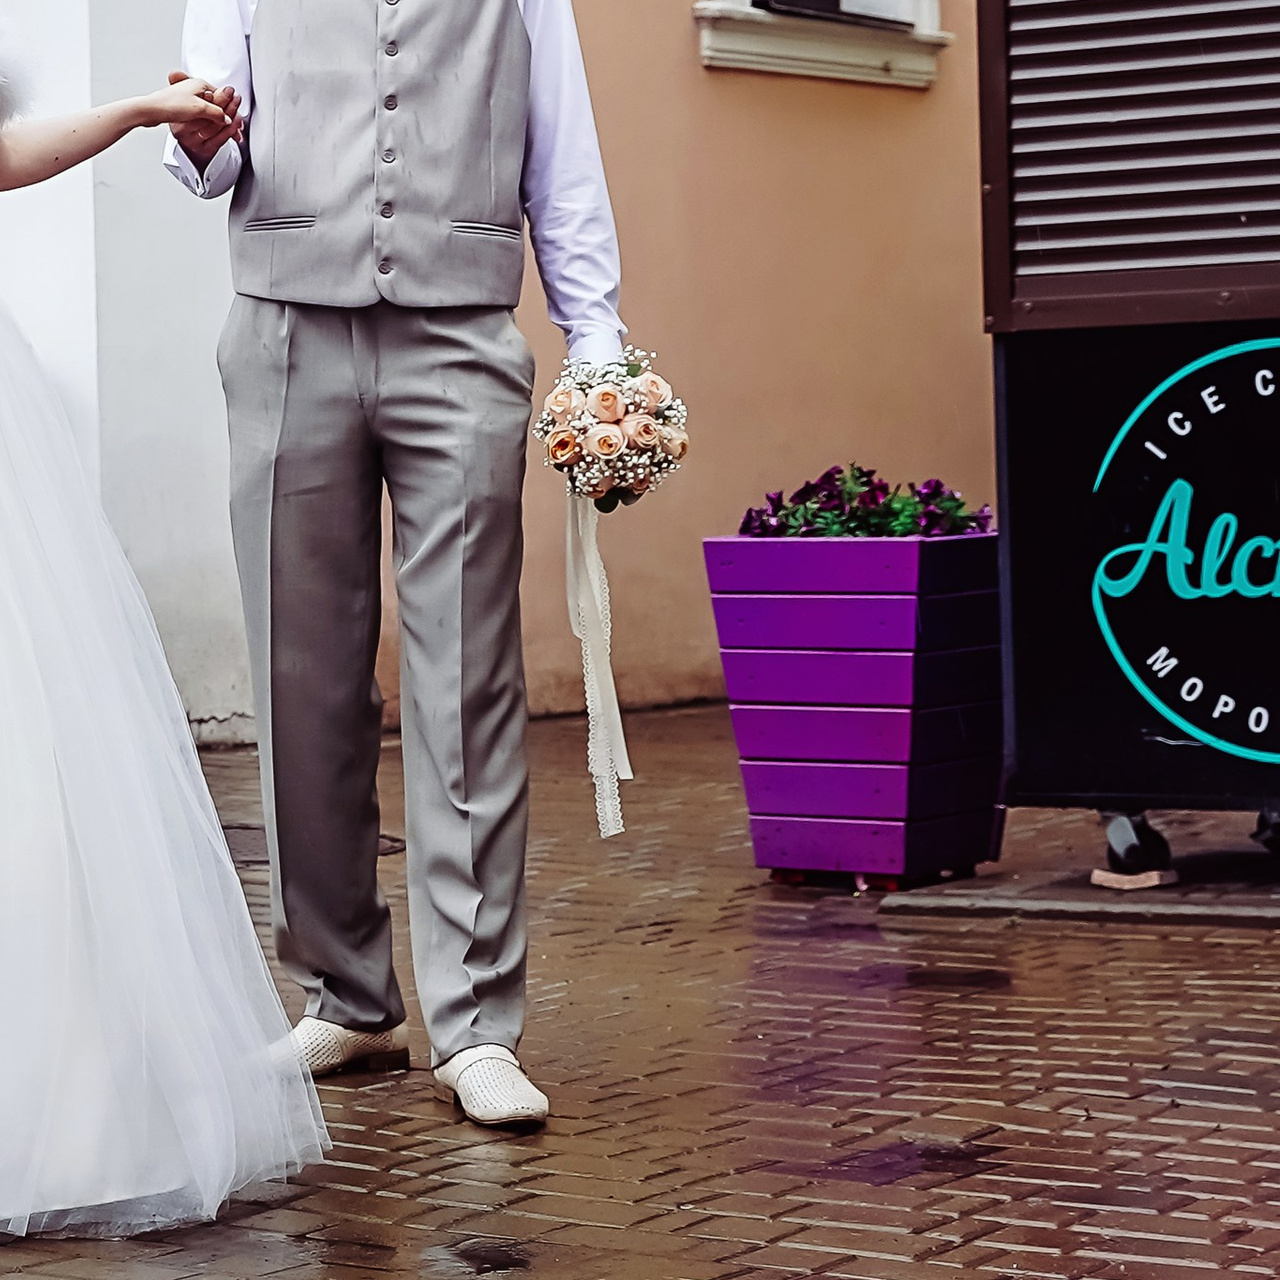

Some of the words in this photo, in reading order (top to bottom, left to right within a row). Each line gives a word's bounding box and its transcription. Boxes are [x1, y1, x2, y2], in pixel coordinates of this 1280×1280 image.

[1144, 385, 1226, 460] ICE
[1091, 477, 1280, 600] Alc
[1146, 645, 1270, 733] МОРО
